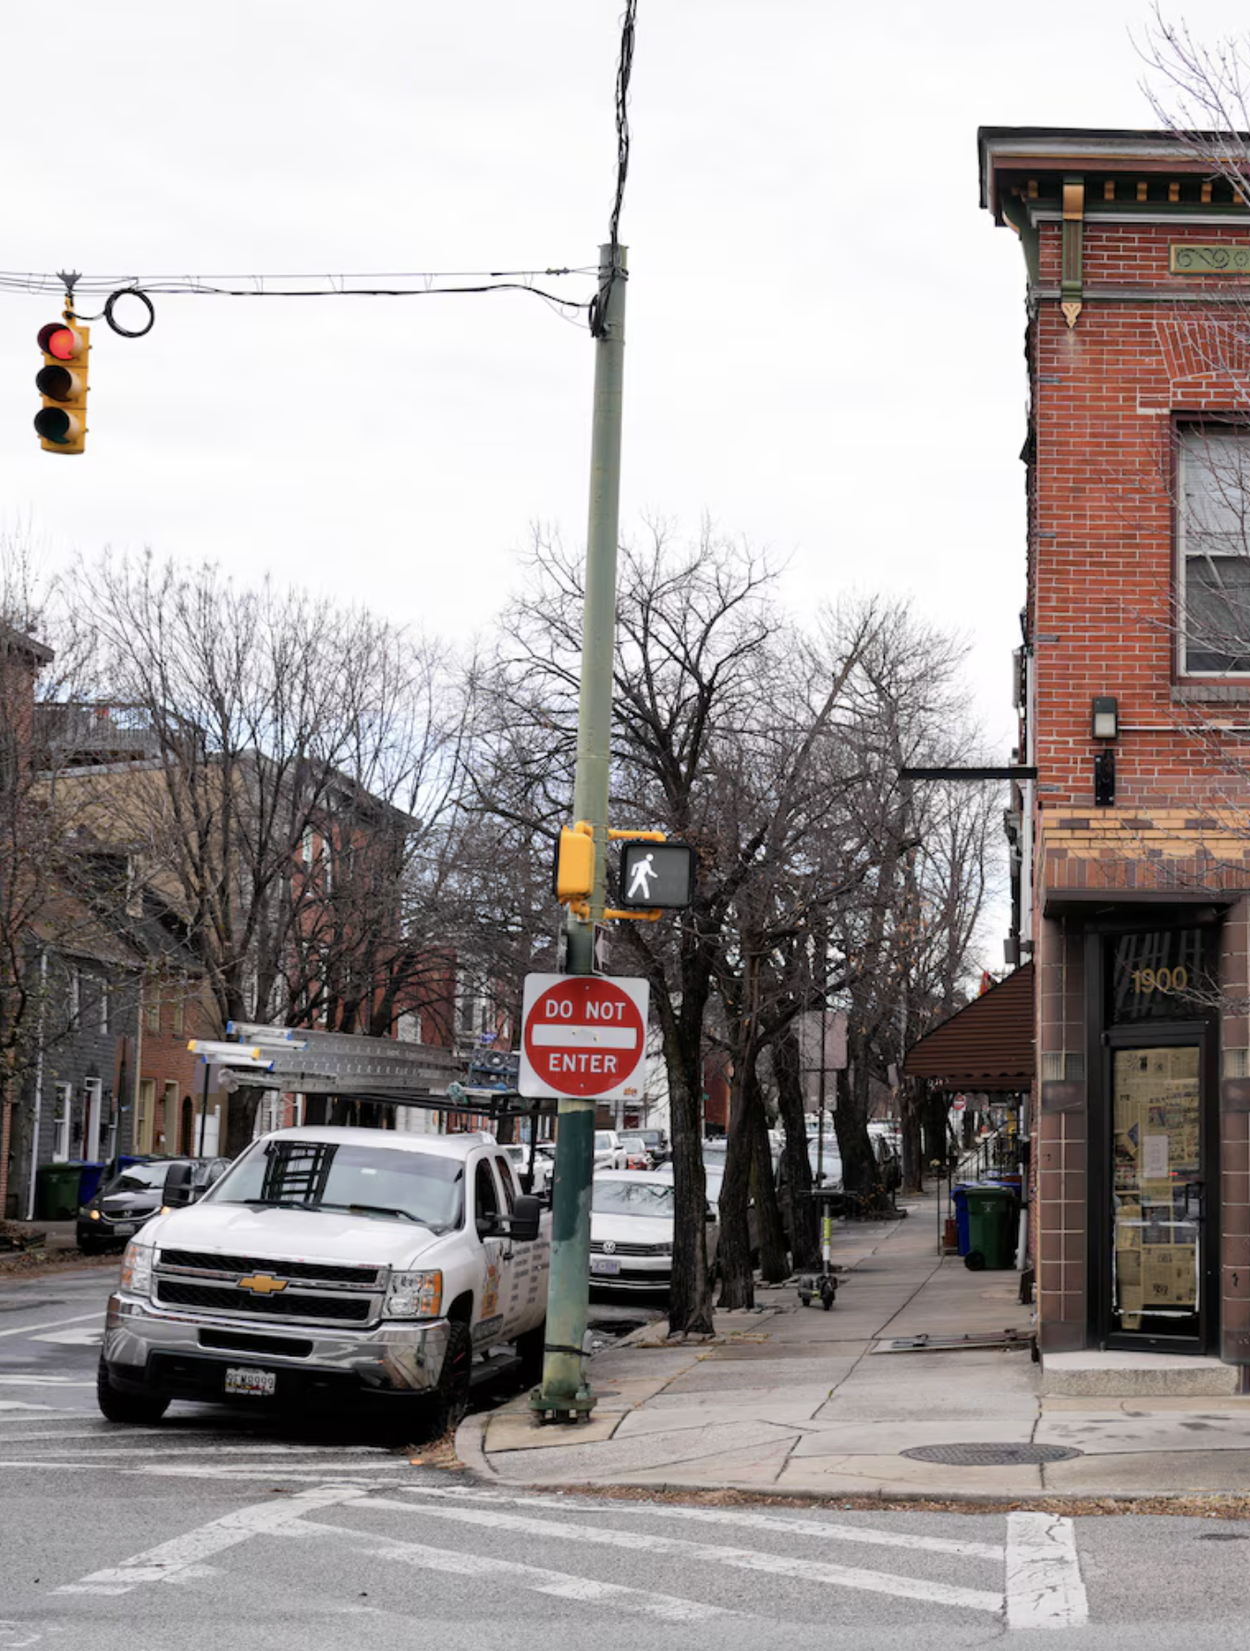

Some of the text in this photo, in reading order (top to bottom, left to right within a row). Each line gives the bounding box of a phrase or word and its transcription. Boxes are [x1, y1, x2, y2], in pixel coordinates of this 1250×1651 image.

[1131, 966, 1188, 994] 1900
[545, 999, 626, 1020] DO NOT
[548, 1053, 617, 1073] ENTER
